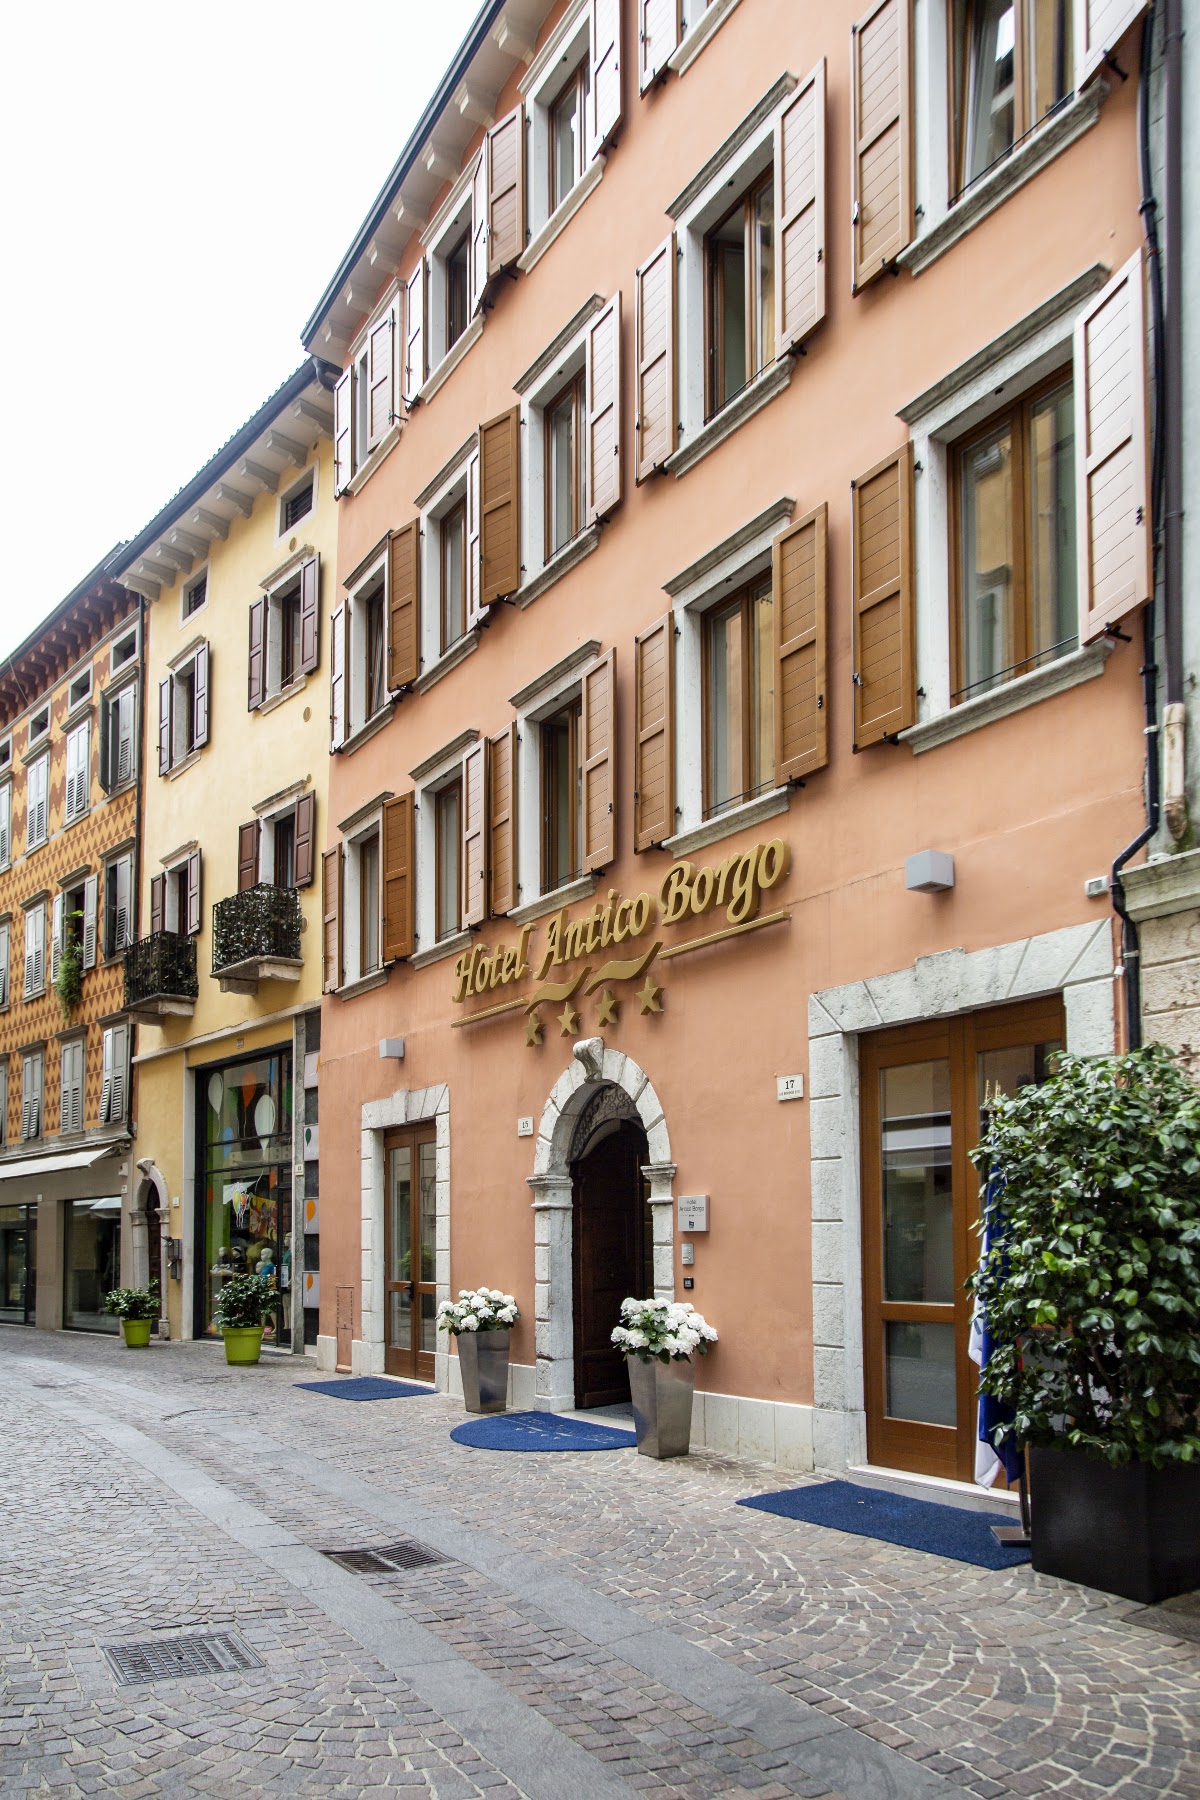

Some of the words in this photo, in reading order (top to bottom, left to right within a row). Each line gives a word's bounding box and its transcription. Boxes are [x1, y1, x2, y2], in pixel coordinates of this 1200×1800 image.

[451, 923, 537, 1003] Hotel
[533, 888, 655, 981] Antico
[658, 837, 790, 927] Borgo
[785, 1079, 795, 1090] 17
